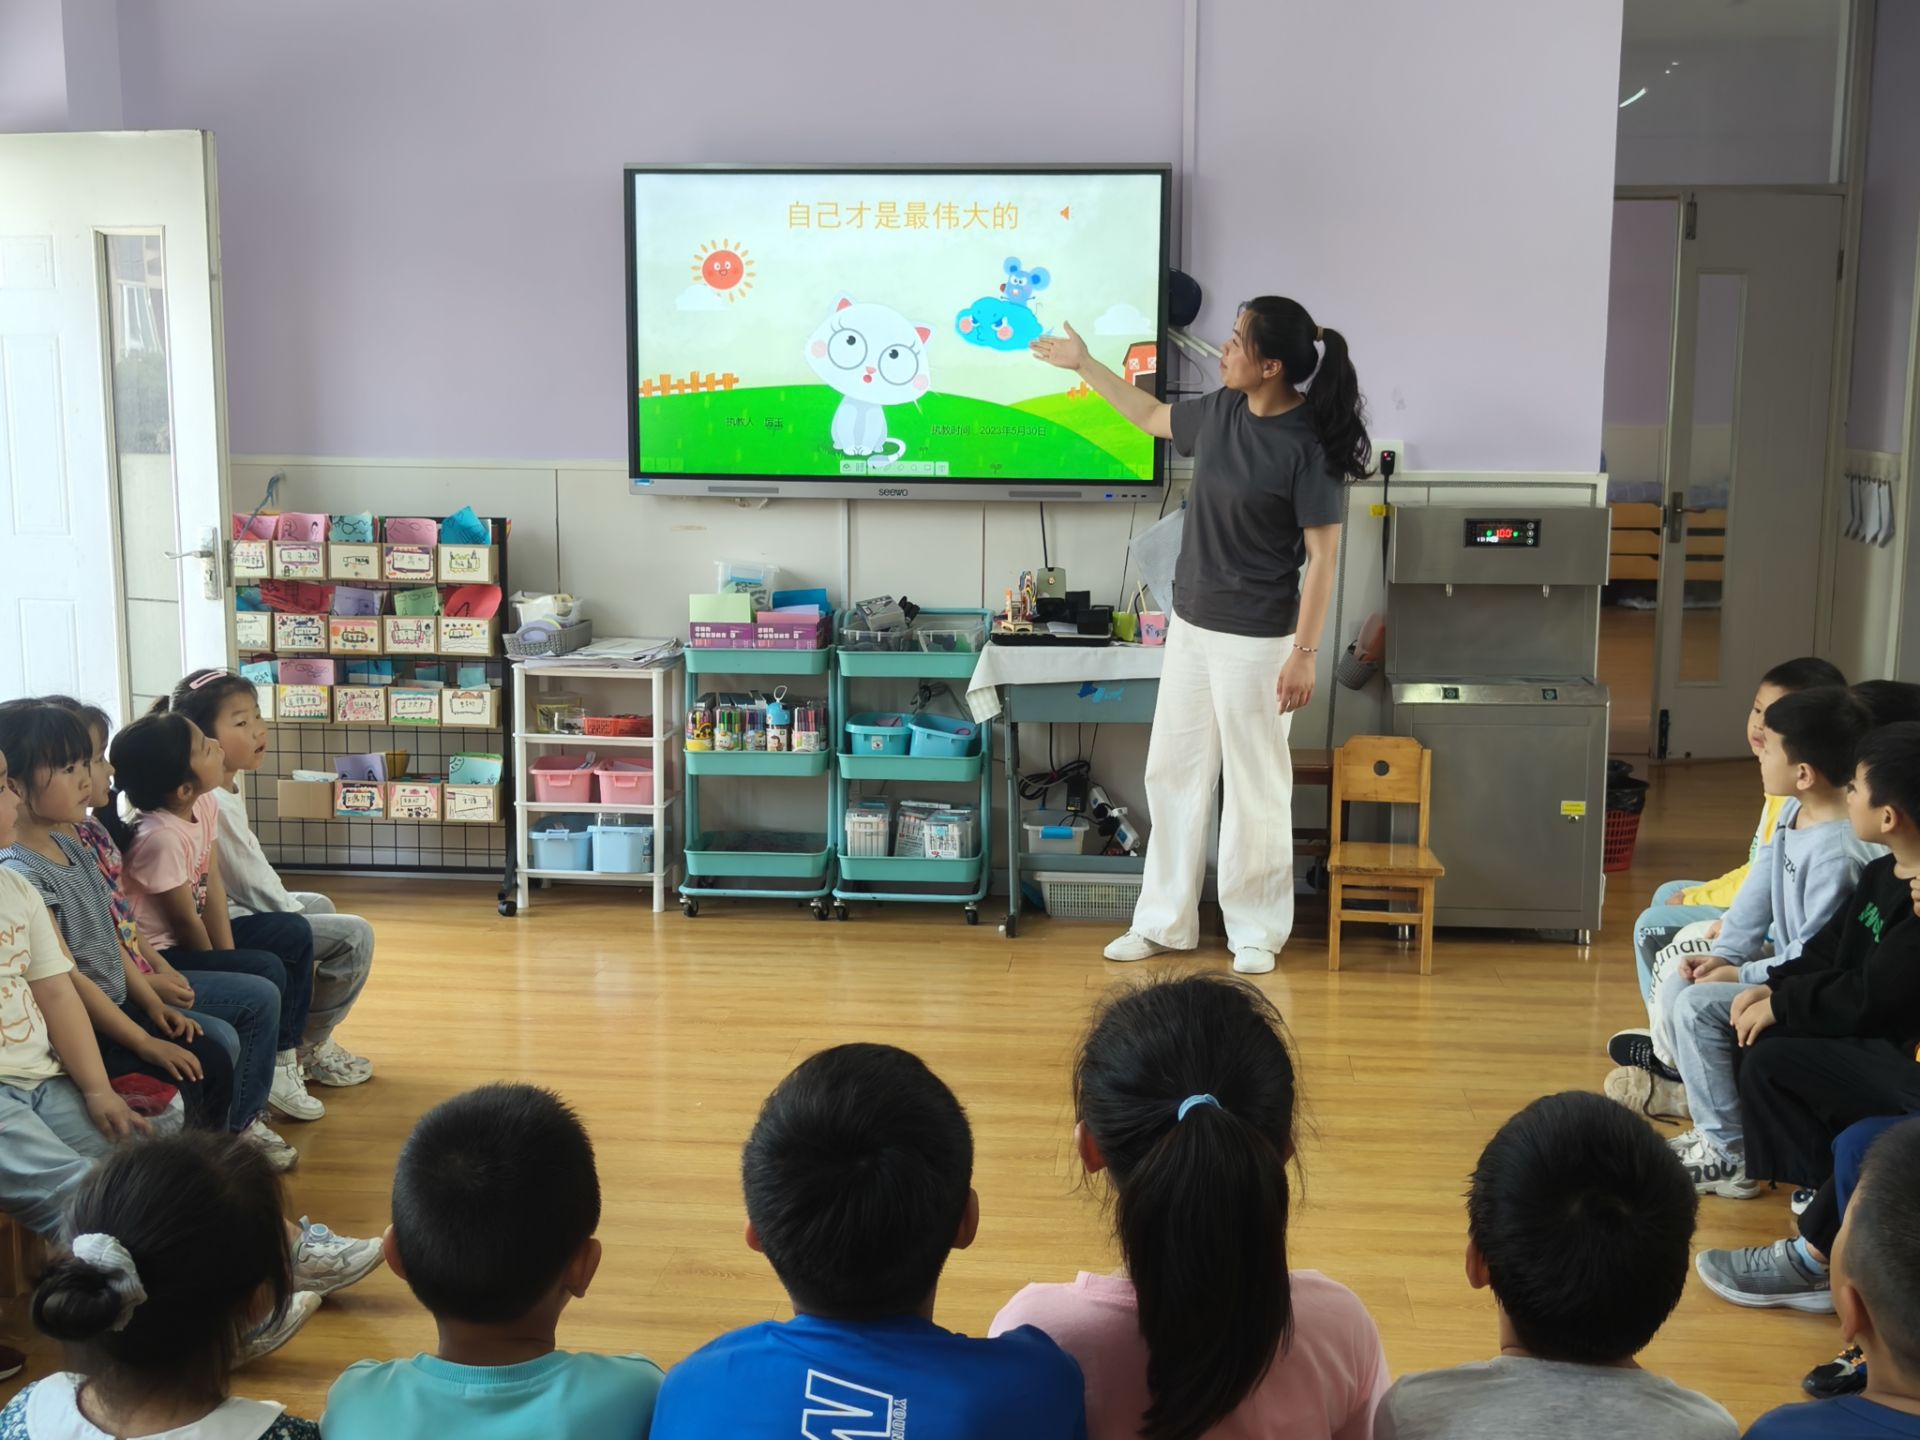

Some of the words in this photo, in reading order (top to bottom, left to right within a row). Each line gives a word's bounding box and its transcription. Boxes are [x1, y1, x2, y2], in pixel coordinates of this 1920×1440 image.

[788, 201, 1018, 229] 自己才是最伟大的
[879, 488, 908, 496] seewo
